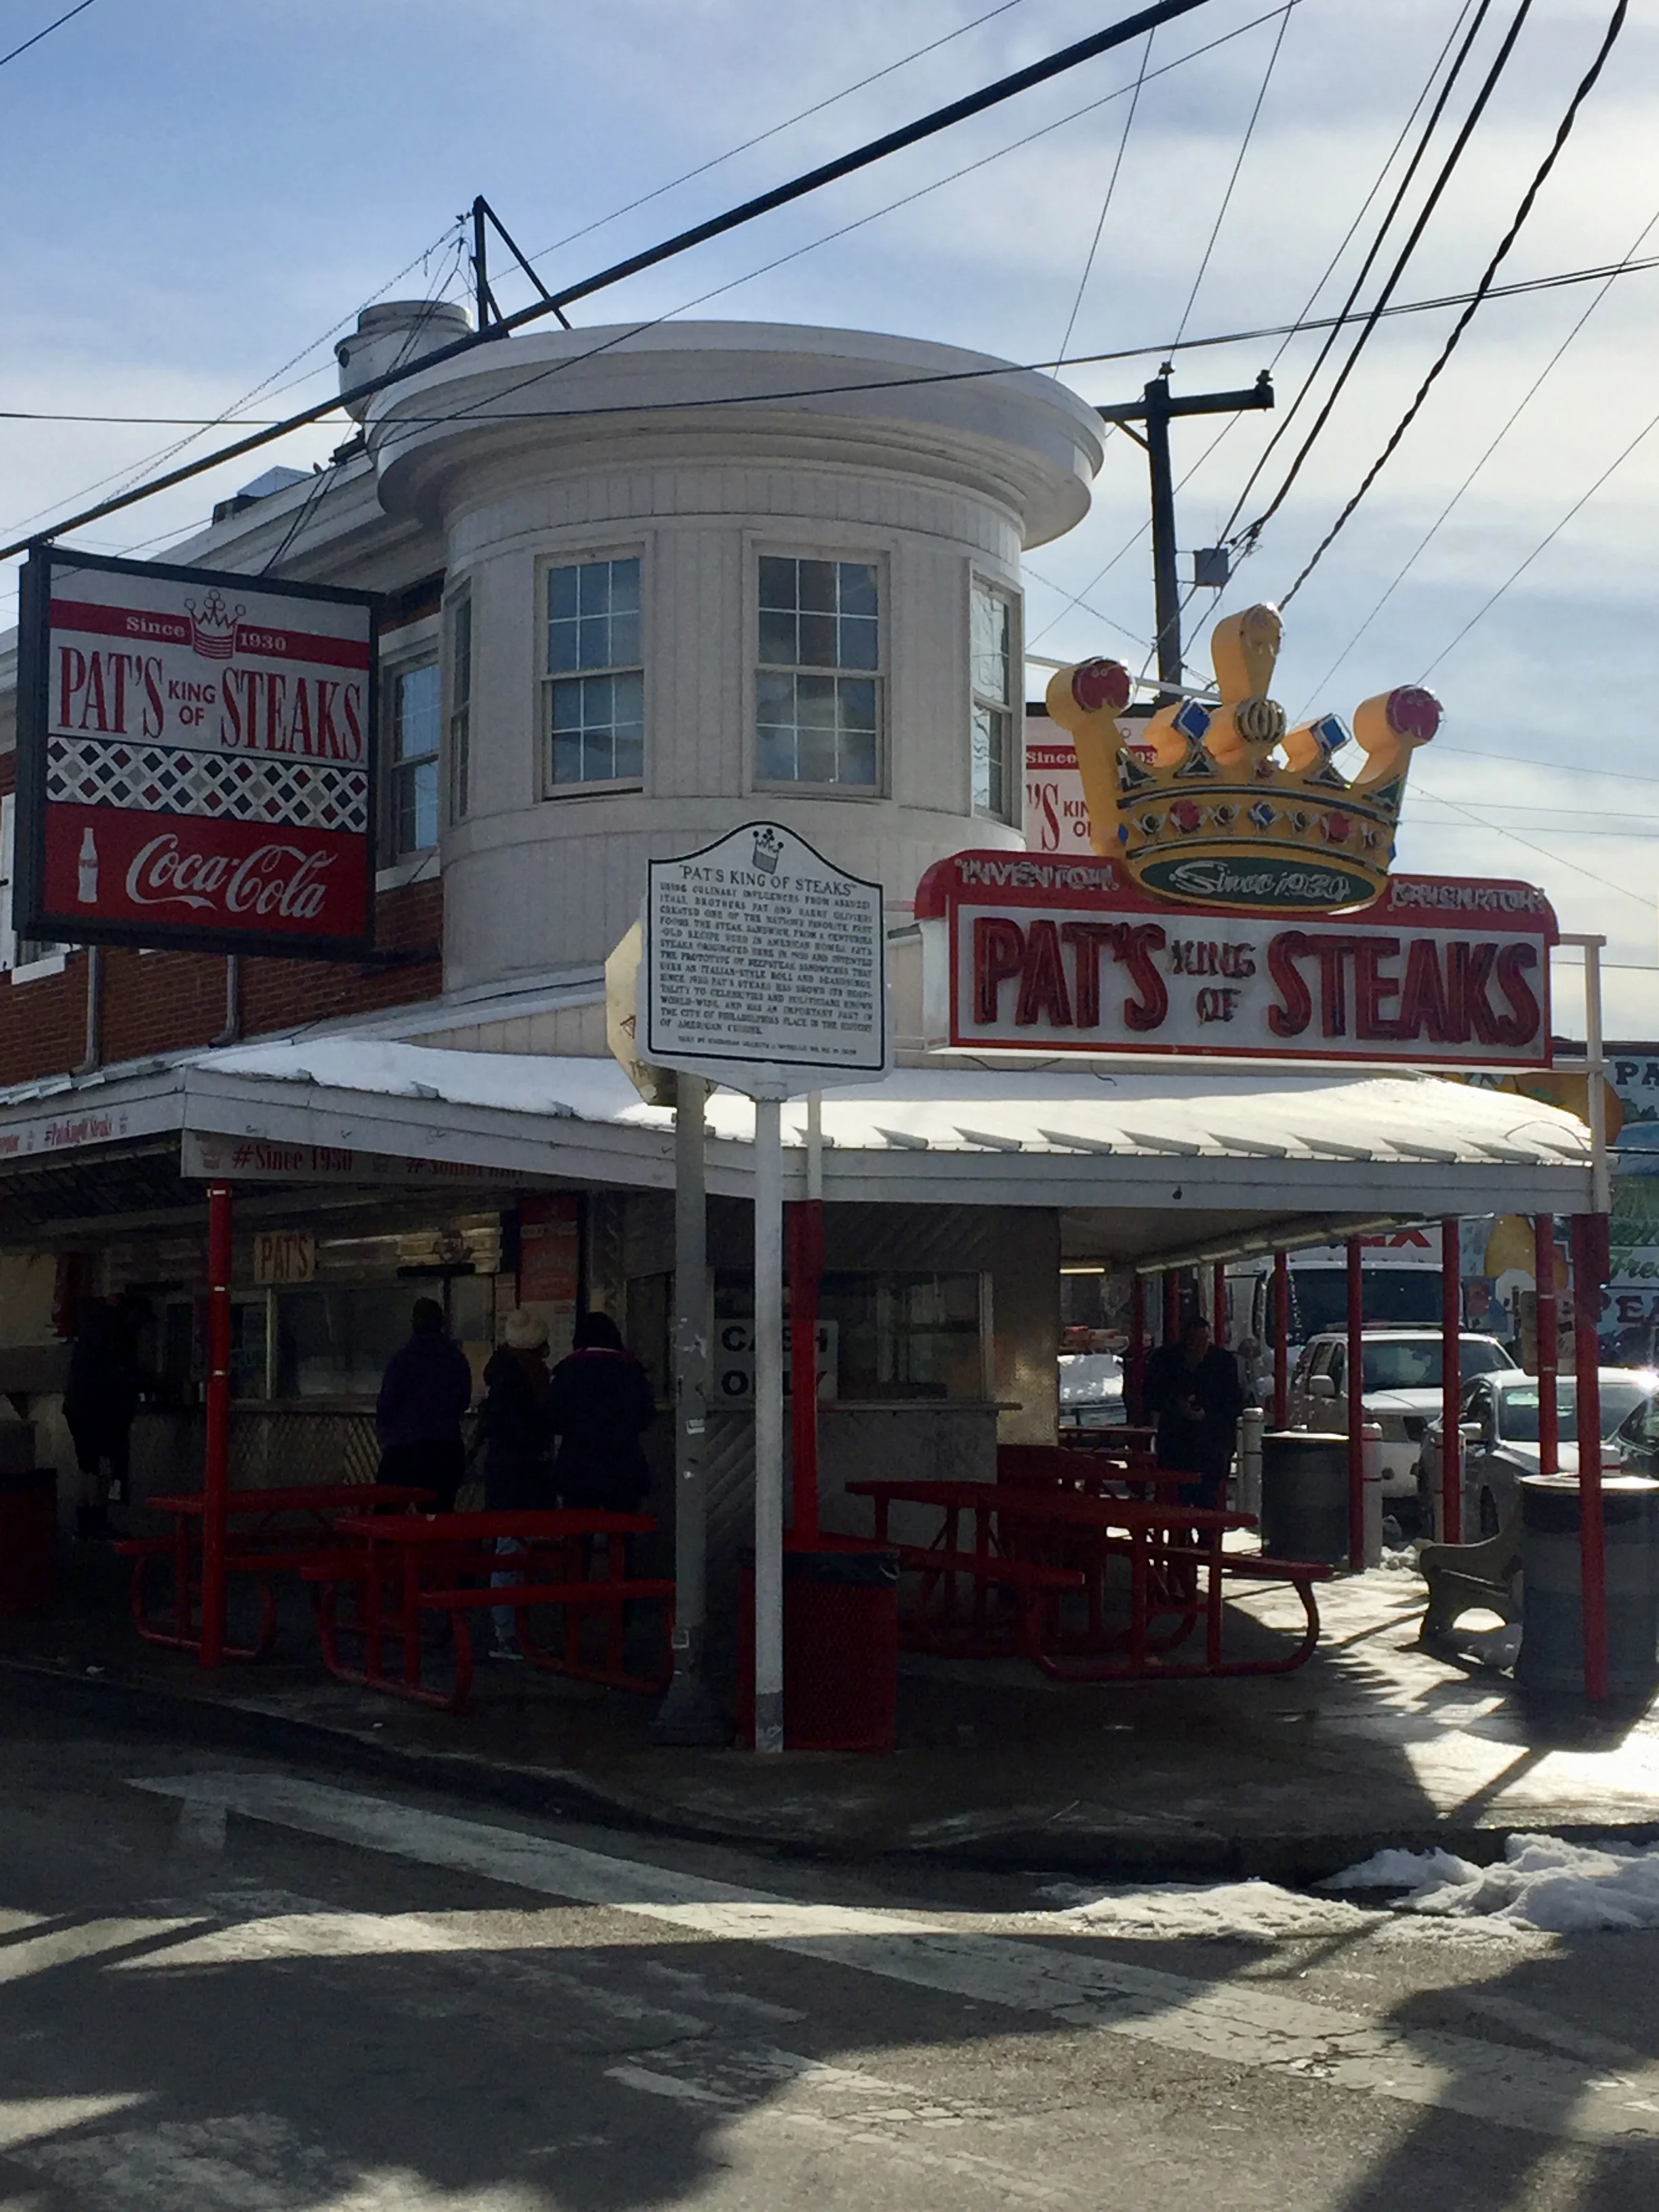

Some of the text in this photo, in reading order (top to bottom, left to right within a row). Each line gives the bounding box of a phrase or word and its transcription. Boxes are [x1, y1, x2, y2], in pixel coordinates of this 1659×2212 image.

[127, 616, 287, 652] Since 1930
[58, 646, 362, 763] PAT'S KING OF STEAKS
[1063, 801, 1090, 817] KIN
[126, 832, 339, 920] Coca-Cola
[730, 869, 766, 888] KING
[770, 875, 790, 890] OF
[1169, 860, 1351, 902] Since 1930
[692, 884, 737, 897] CULINARY
[752, 903, 768, 913] PAT
[743, 912, 761, 923] THE
[715, 921, 743, 933] STEAK
[660, 949, 677, 960] THE
[973, 917, 1542, 1046] PAT'S KING OF STEAKS
[693, 986, 706, 996] TO
[660, 1006, 677, 1016] THE
[260, 1233, 309, 1280] PAT'S
